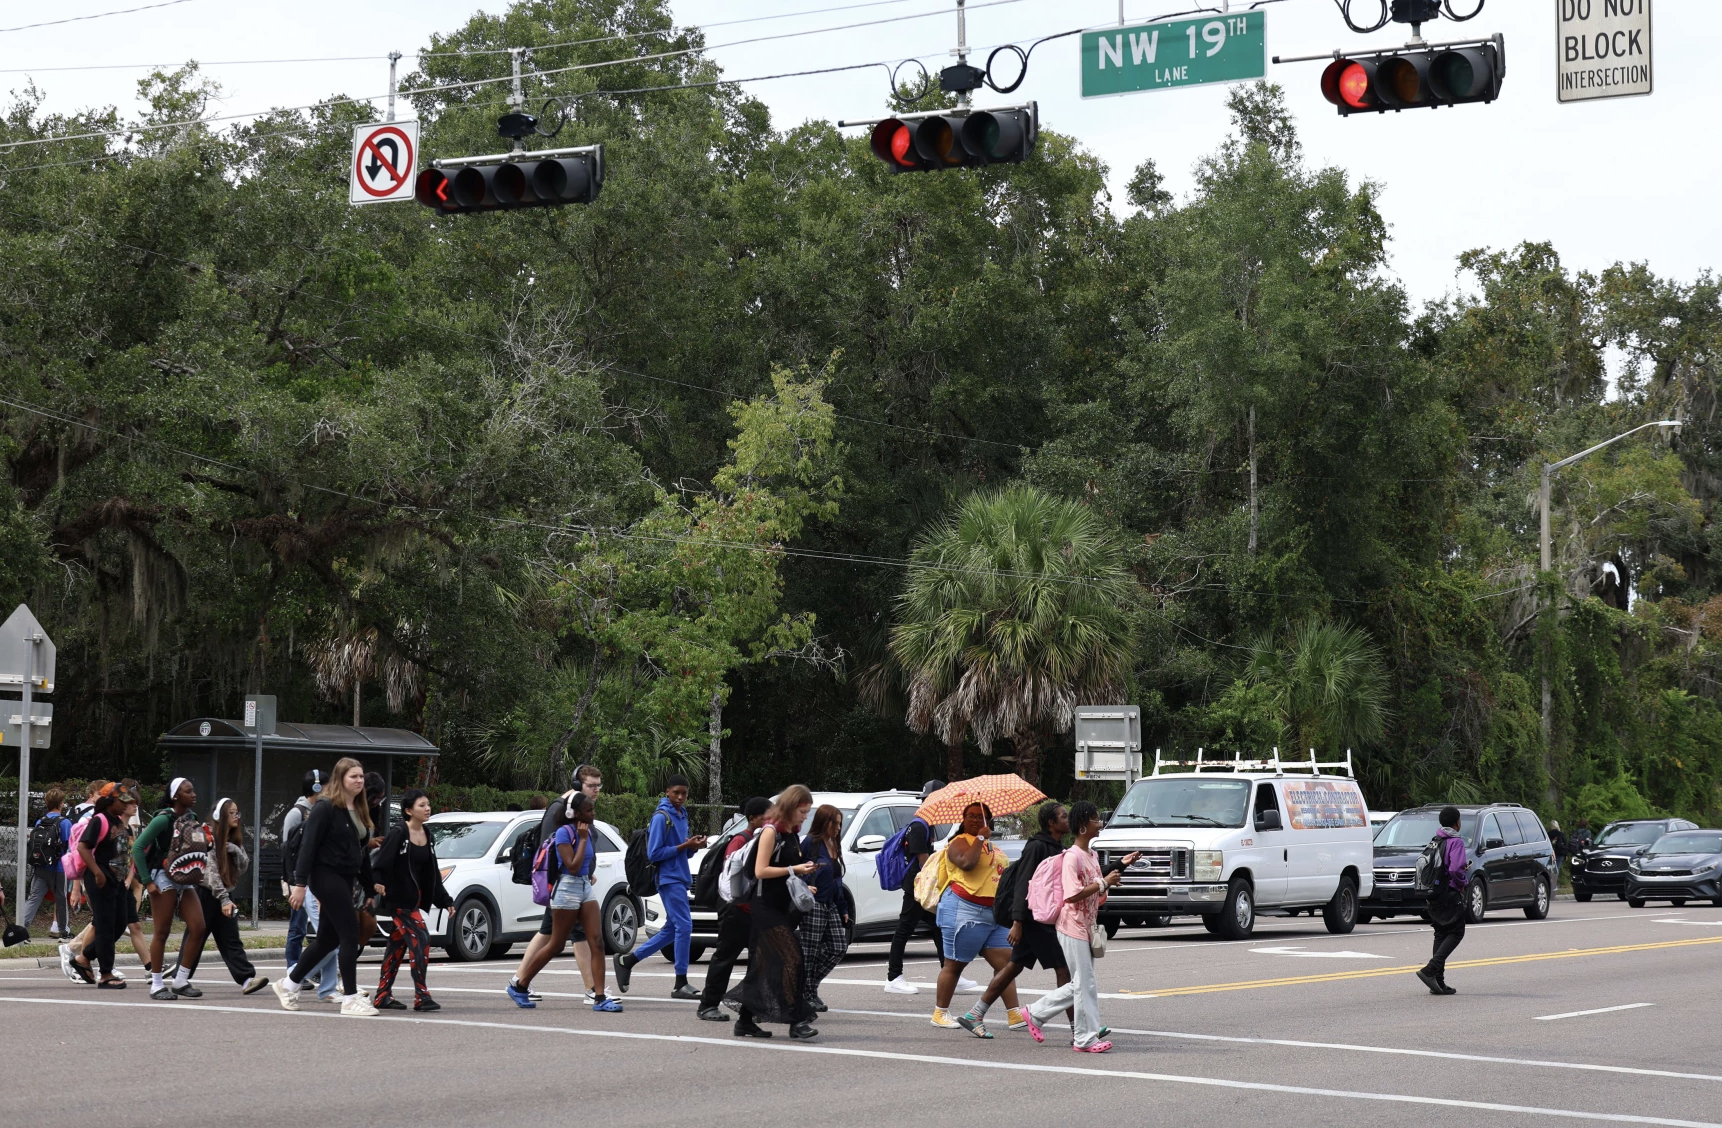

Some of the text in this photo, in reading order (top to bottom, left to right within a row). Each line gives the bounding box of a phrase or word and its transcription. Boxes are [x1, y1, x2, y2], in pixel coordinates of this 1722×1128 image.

[1563, 0, 1591, 22] DO
[1098, 17, 1247, 70] NW 19TH
[1565, 29, 1643, 62] BLOCK
[1155, 66, 1188, 83] LANE
[1561, 64, 1648, 90] INTERSECTION
[1289, 790, 1360, 805] ELECTRICAL CONTRACTOR
